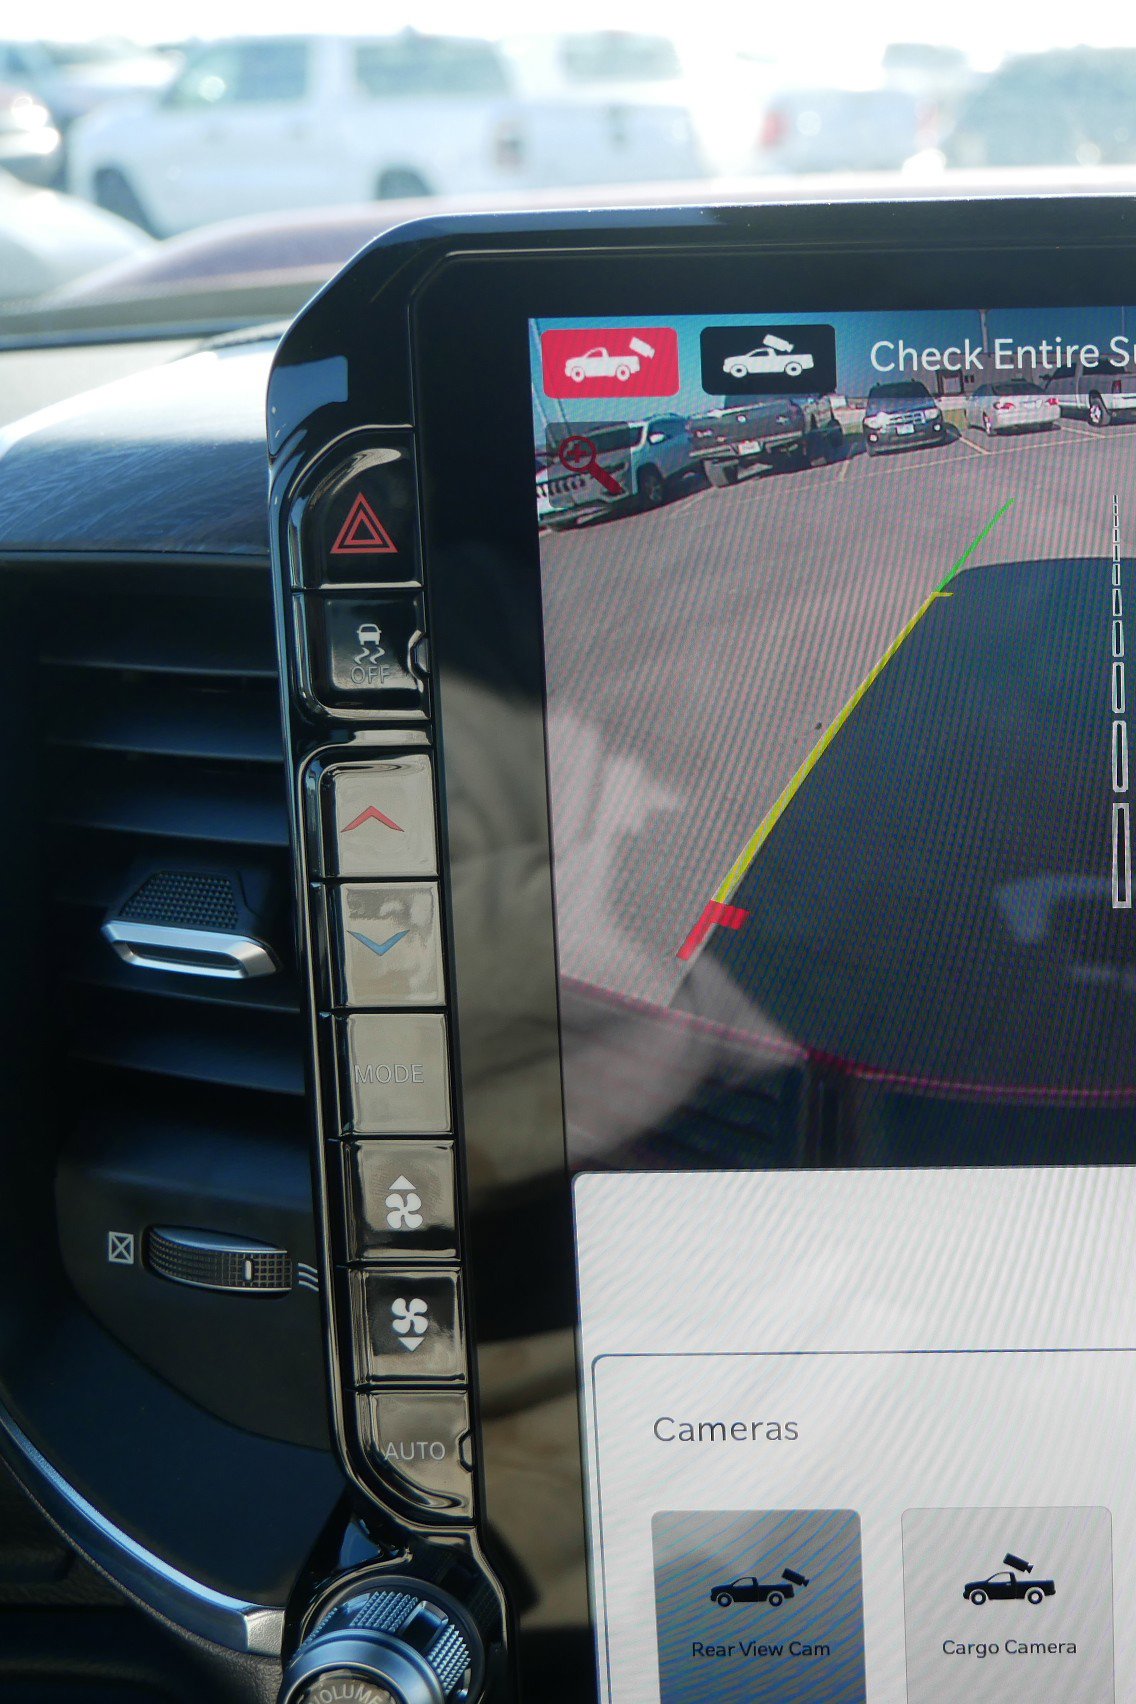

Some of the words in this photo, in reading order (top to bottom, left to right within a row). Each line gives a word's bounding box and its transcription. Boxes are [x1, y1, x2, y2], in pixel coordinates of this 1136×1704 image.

[870, 338, 983, 372] Check
[994, 336, 1099, 370] Entire
[350, 666, 391, 684] OFF
[354, 1064, 424, 1084] MODE
[653, 1416, 799, 1442] Cameras
[384, 1441, 446, 1461] AUTO
[692, 1641, 735, 1657] Rear
[739, 1640, 783, 1657] View
[789, 1641, 830, 1656] Cam
[942, 1639, 1000, 1659] Cargo
[1005, 1639, 1077, 1654] Camera
